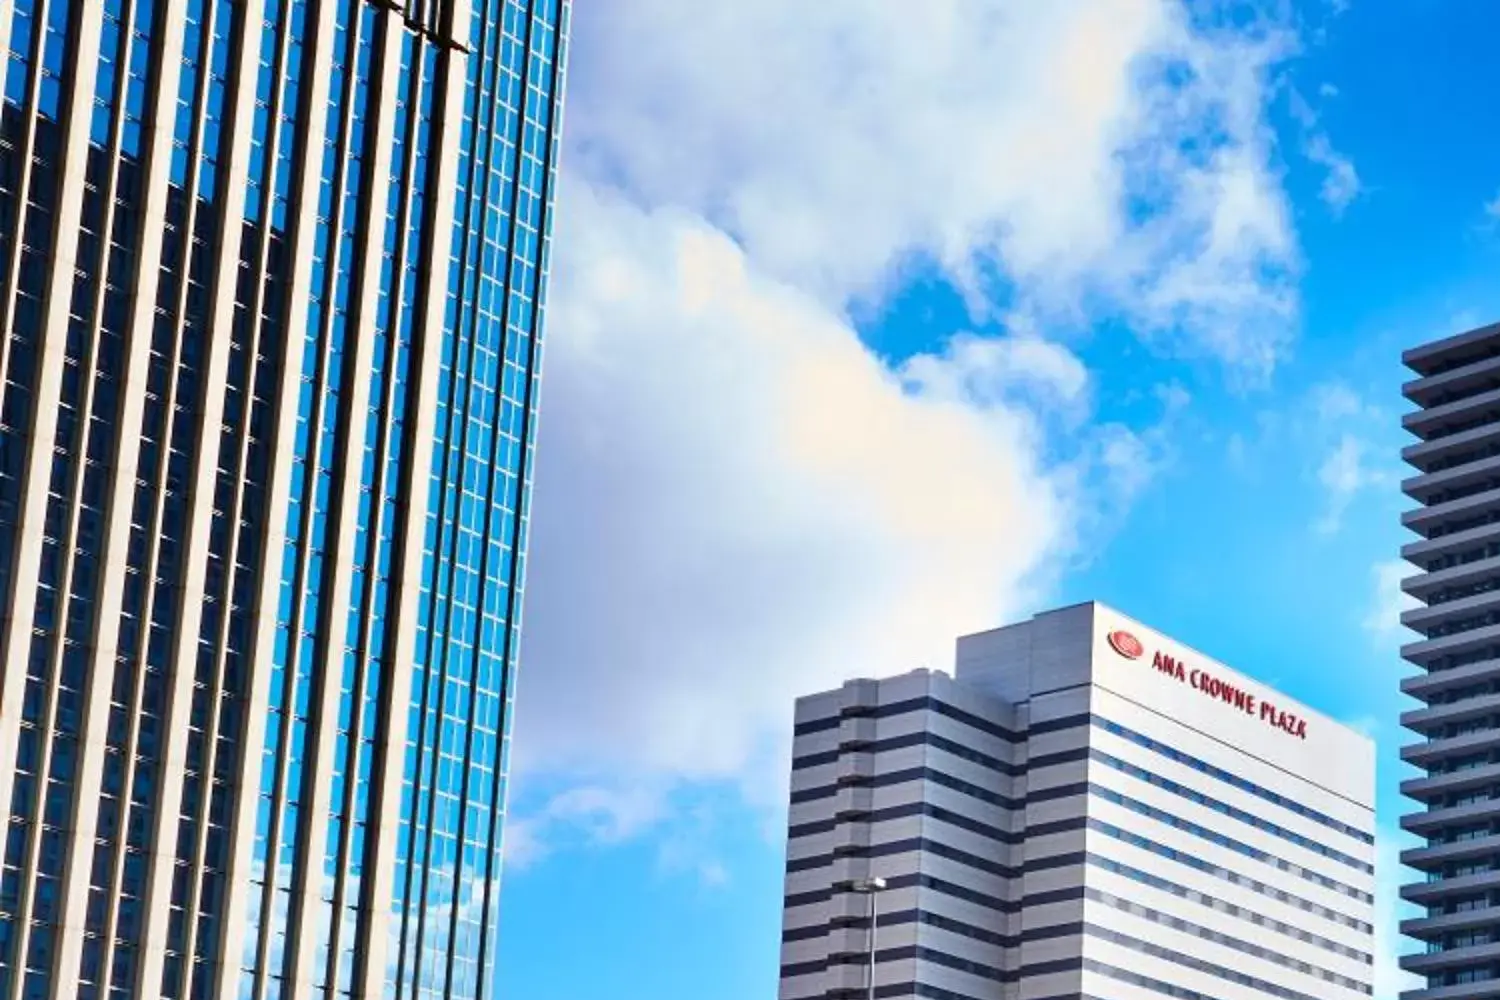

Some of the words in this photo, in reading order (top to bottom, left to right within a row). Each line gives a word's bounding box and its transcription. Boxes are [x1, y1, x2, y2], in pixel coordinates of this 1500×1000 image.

[1151, 650, 1185, 682] ANA
[1190, 669, 1256, 715] CROWNE
[1260, 701, 1307, 740] PLAZA
